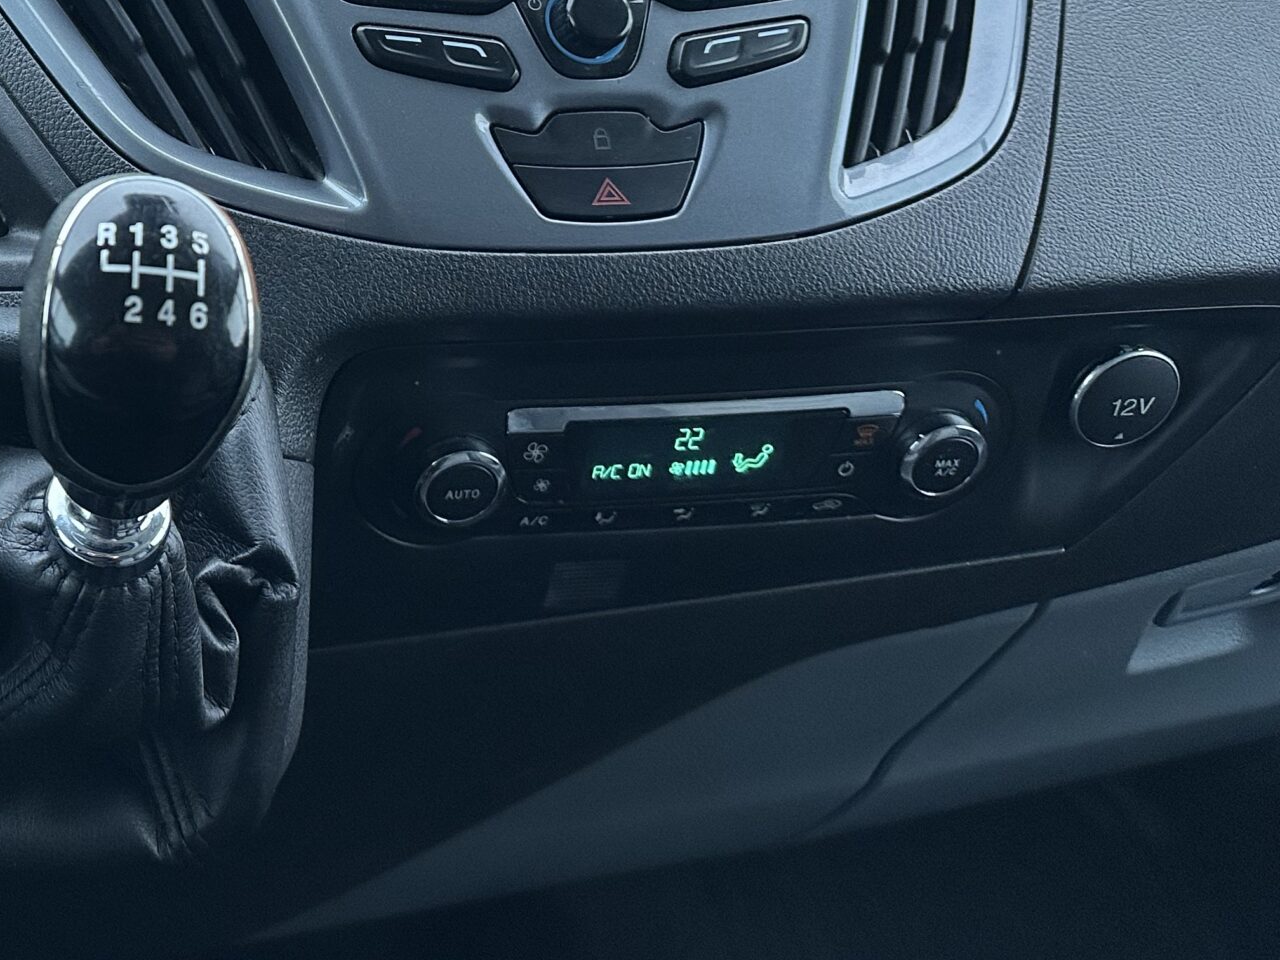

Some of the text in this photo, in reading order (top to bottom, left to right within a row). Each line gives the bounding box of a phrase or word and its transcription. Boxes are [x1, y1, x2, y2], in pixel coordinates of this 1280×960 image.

[96, 221, 210, 255] R 1 3 5
[123, 295, 209, 330] 2 4 6
[1112, 396, 1156, 417] 12V
[674, 427, 705, 451] 22
[591, 463, 652, 480] A/C ON
[934, 458, 960, 469] MAX
[934, 467, 958, 477] A/C
[445, 488, 481, 501] AUTO
[520, 515, 549, 527] A/C
